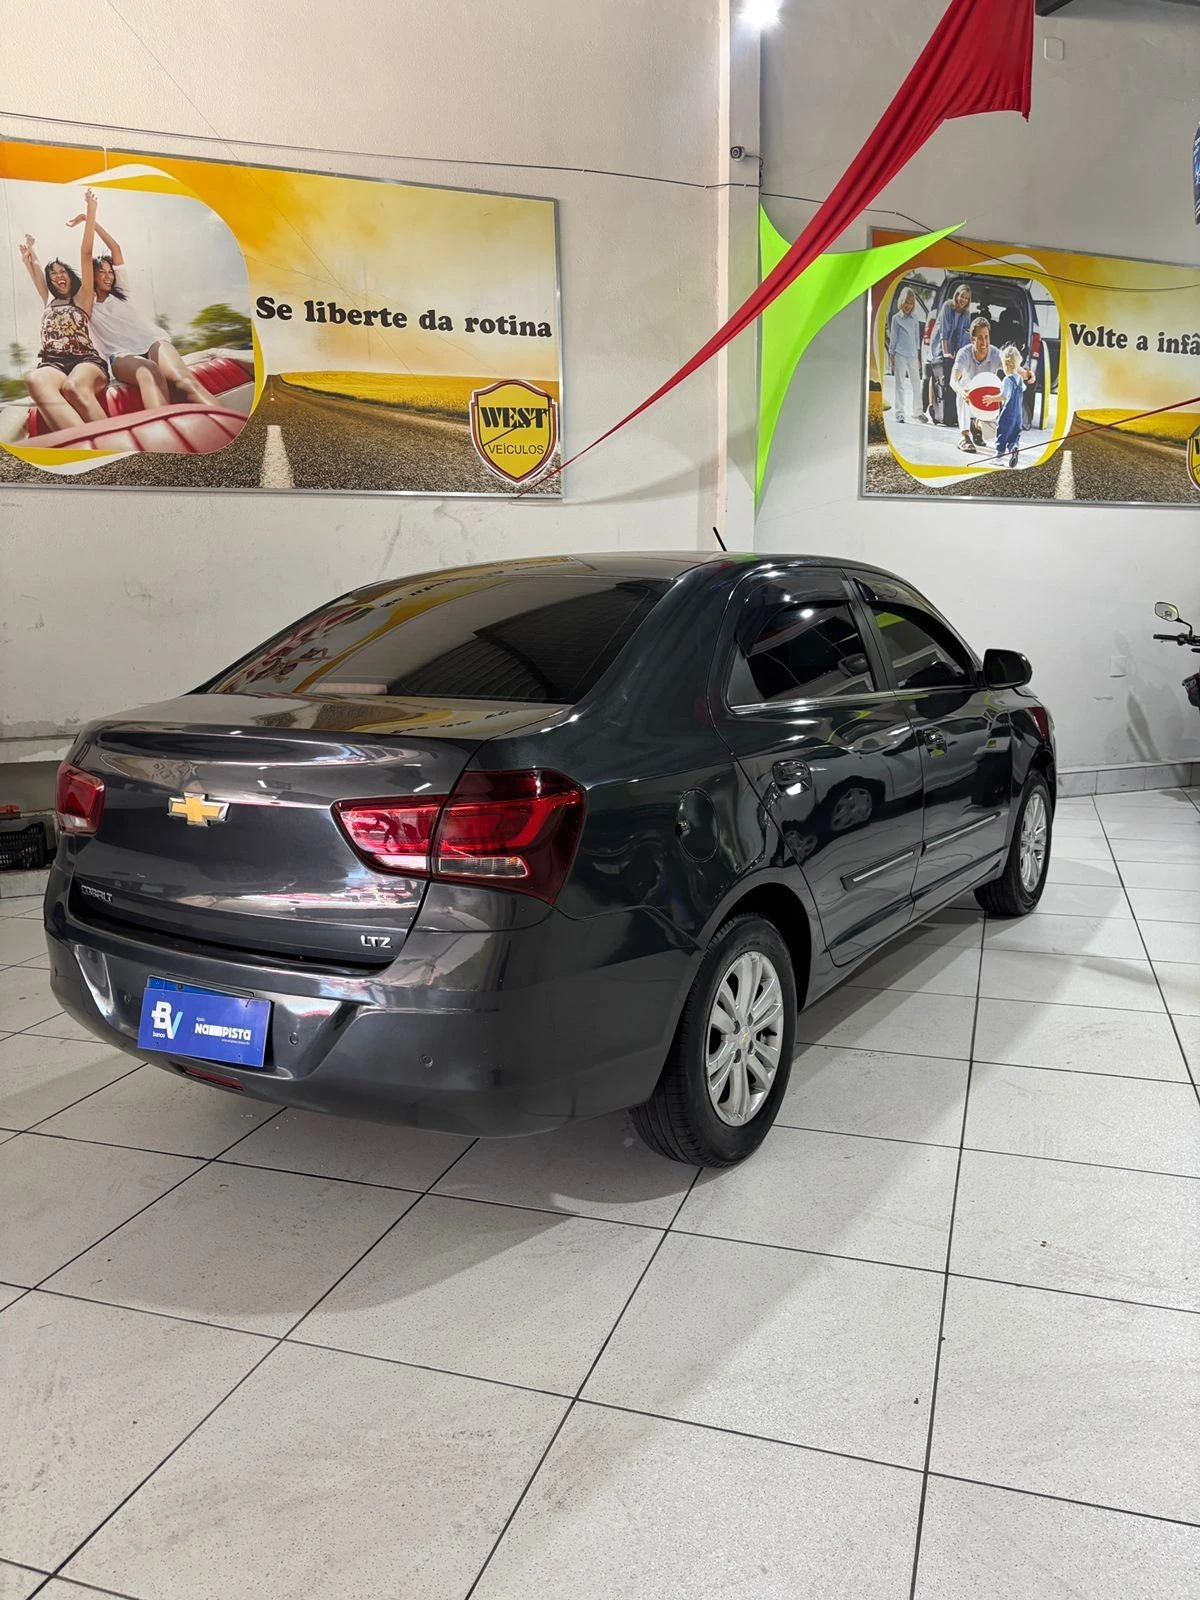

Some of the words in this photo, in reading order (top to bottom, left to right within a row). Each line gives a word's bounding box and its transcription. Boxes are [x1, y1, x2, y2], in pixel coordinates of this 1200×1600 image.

[256, 296, 293, 321] Se
[304, 300, 408, 329] liberte
[419, 309, 454, 332] da
[464, 314, 552, 338] rotina
[1069, 323, 1128, 349] Volte
[1136, 335, 1149, 351] a
[480, 406, 547, 429] WEST
[488, 442, 544, 455] VEÍCULOS
[360, 934, 392, 949] LTZ
